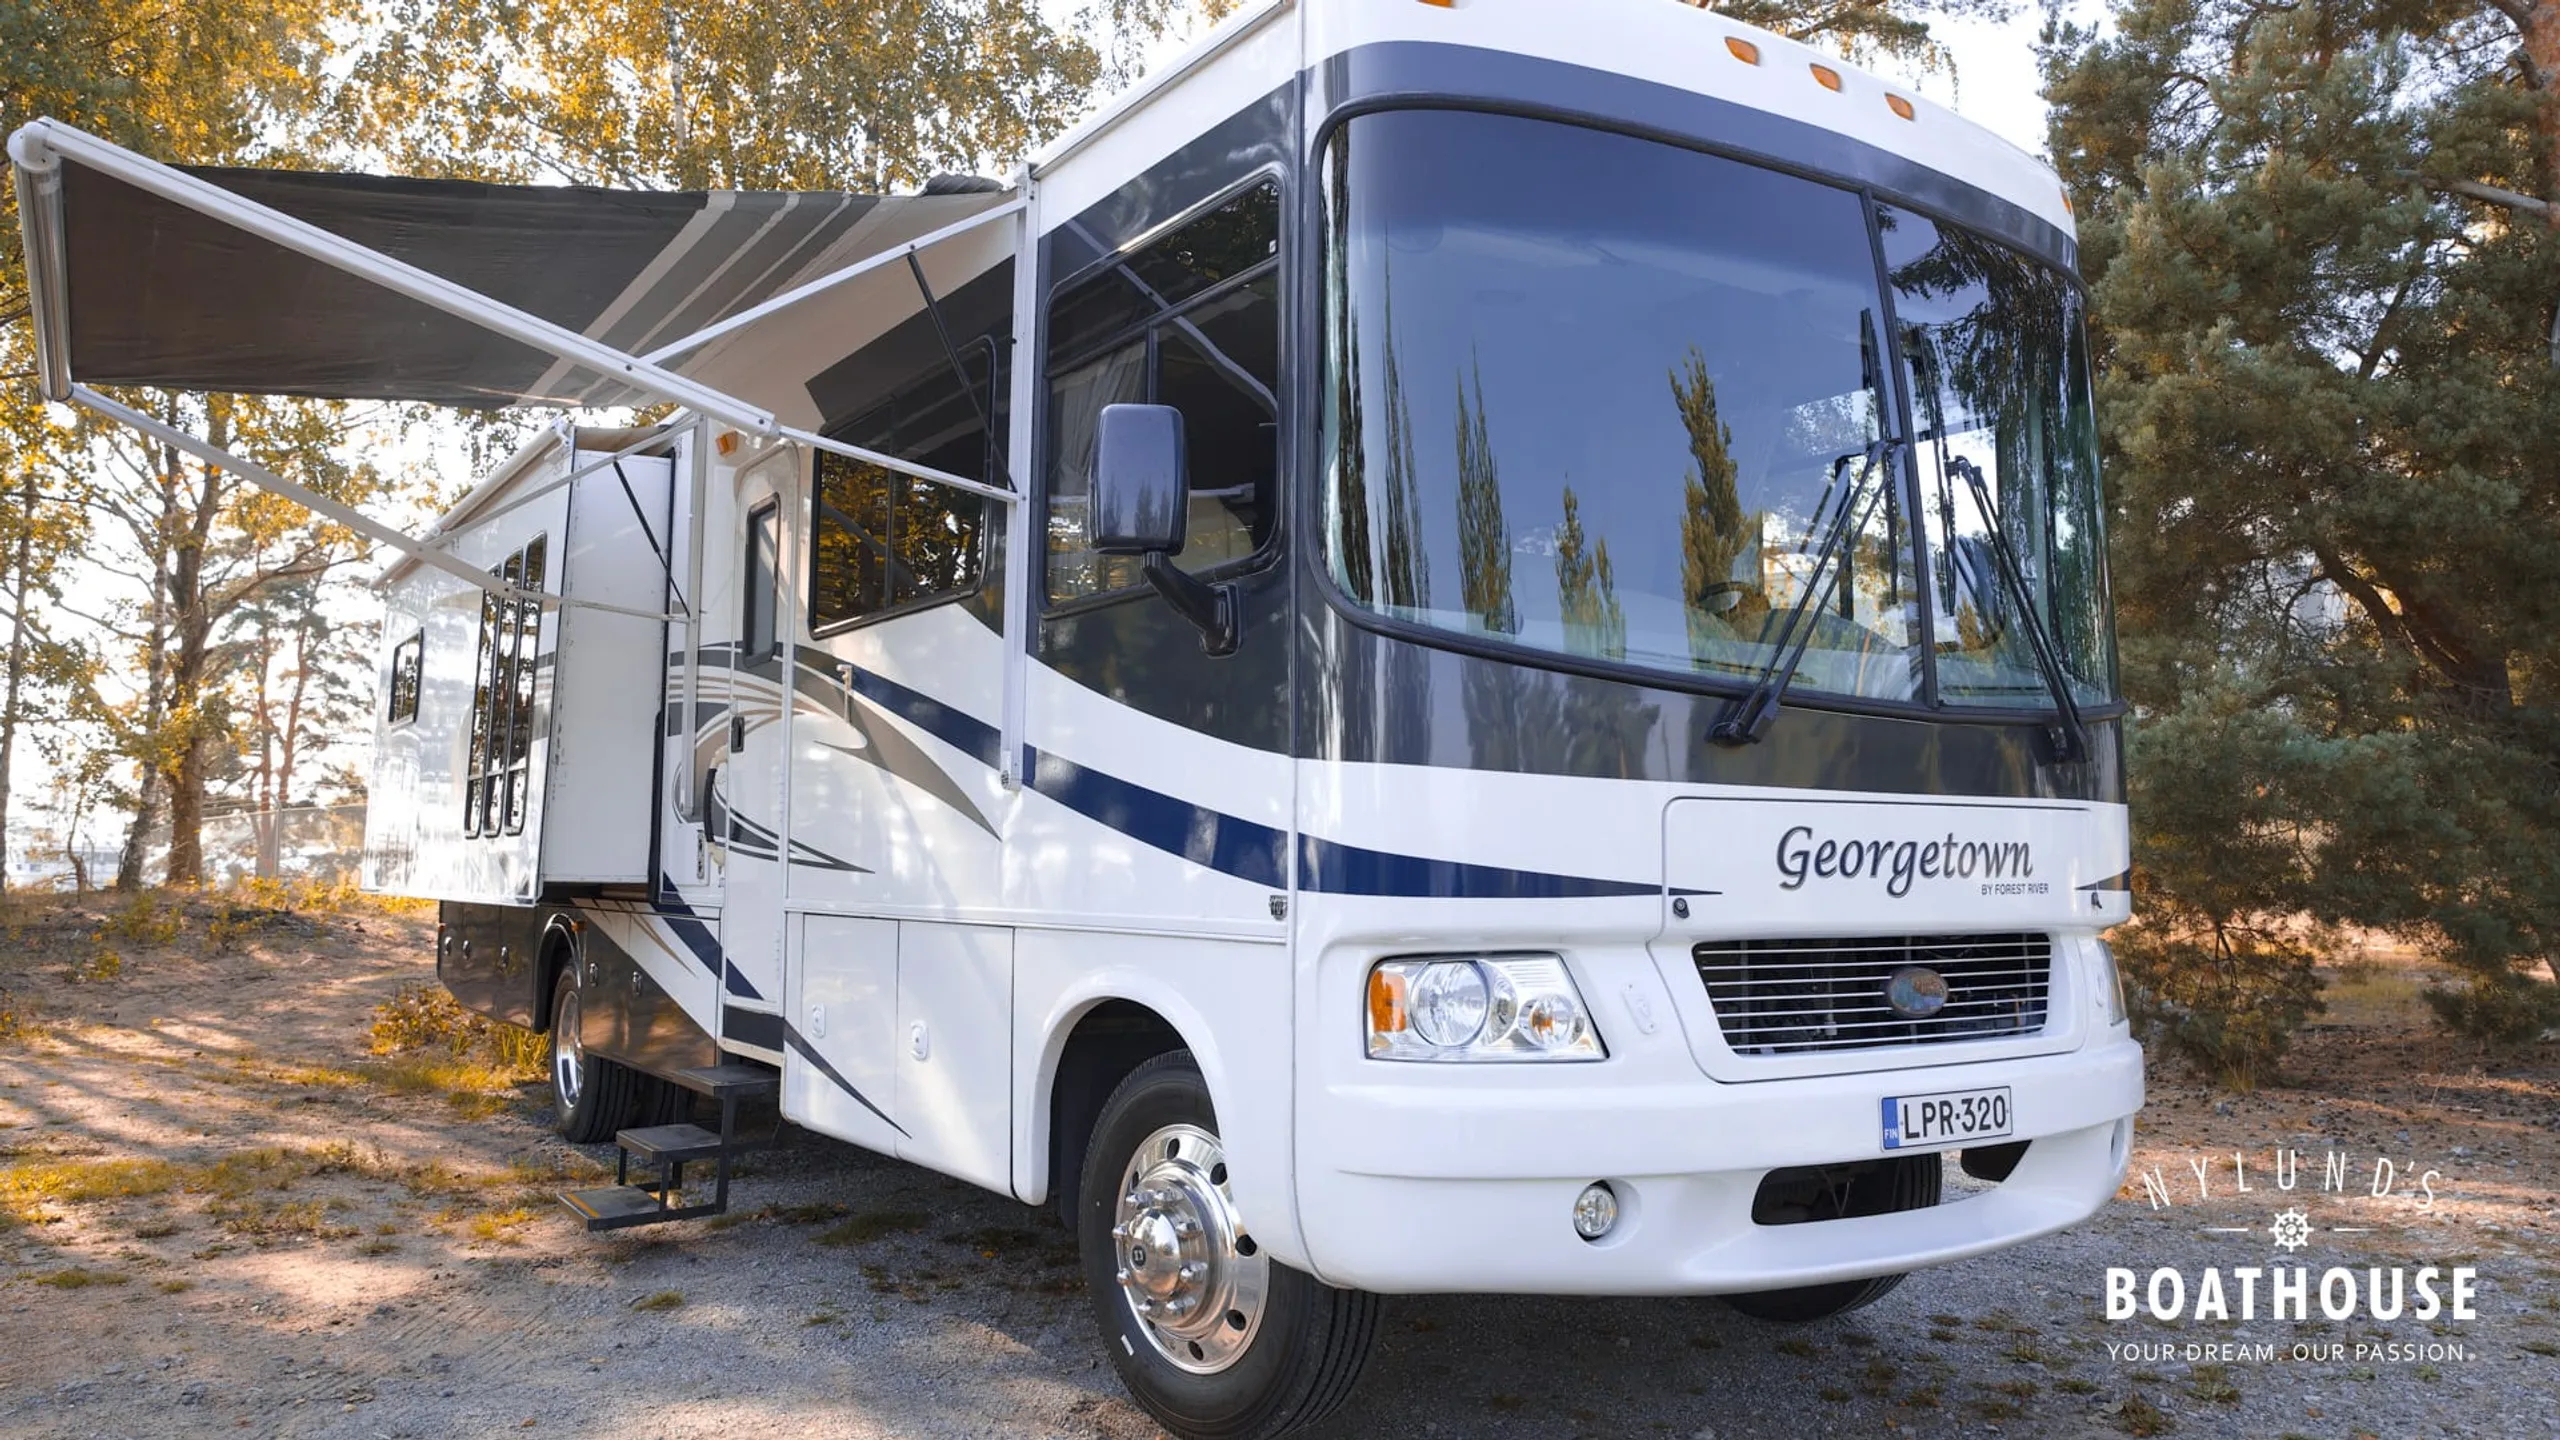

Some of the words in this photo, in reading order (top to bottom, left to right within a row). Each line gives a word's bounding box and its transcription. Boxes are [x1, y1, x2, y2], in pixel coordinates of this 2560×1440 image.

[1776, 826, 2033, 898] Georgetown
[1981, 883, 1993, 895] BY
[1995, 883, 2026, 895] FOREST
[2028, 882, 2049, 894] RIVER
[1884, 1127, 1898, 1140] FIN
[1904, 1094, 2006, 1139] LPR-320
